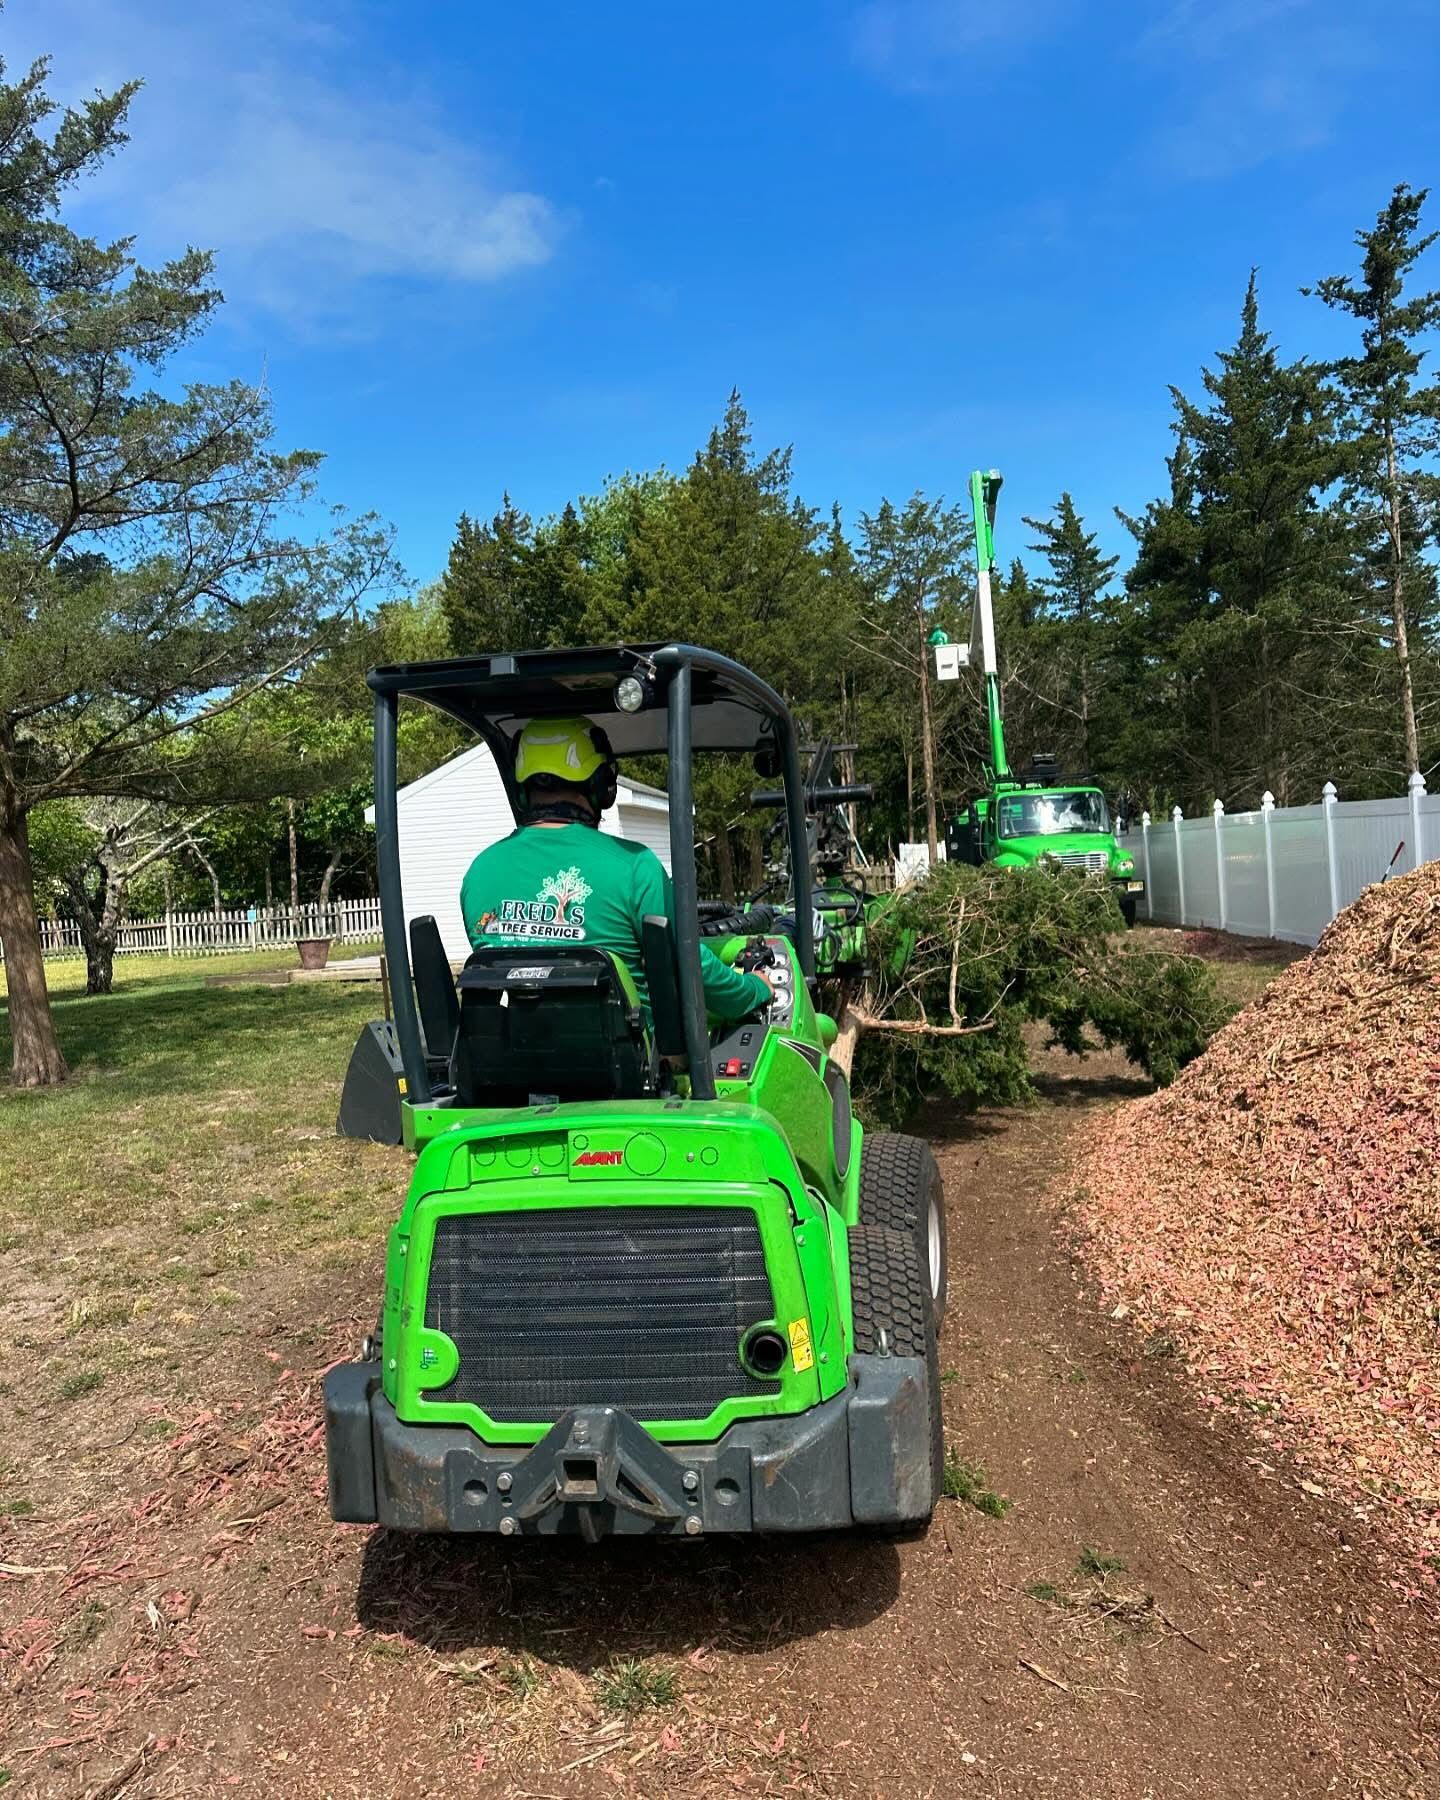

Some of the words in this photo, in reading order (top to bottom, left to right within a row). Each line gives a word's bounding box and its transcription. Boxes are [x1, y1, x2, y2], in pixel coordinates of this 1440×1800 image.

[501, 922, 527, 934] TREE
[530, 925, 580, 939] SERVICE
[572, 1150, 624, 1167] AVANT
